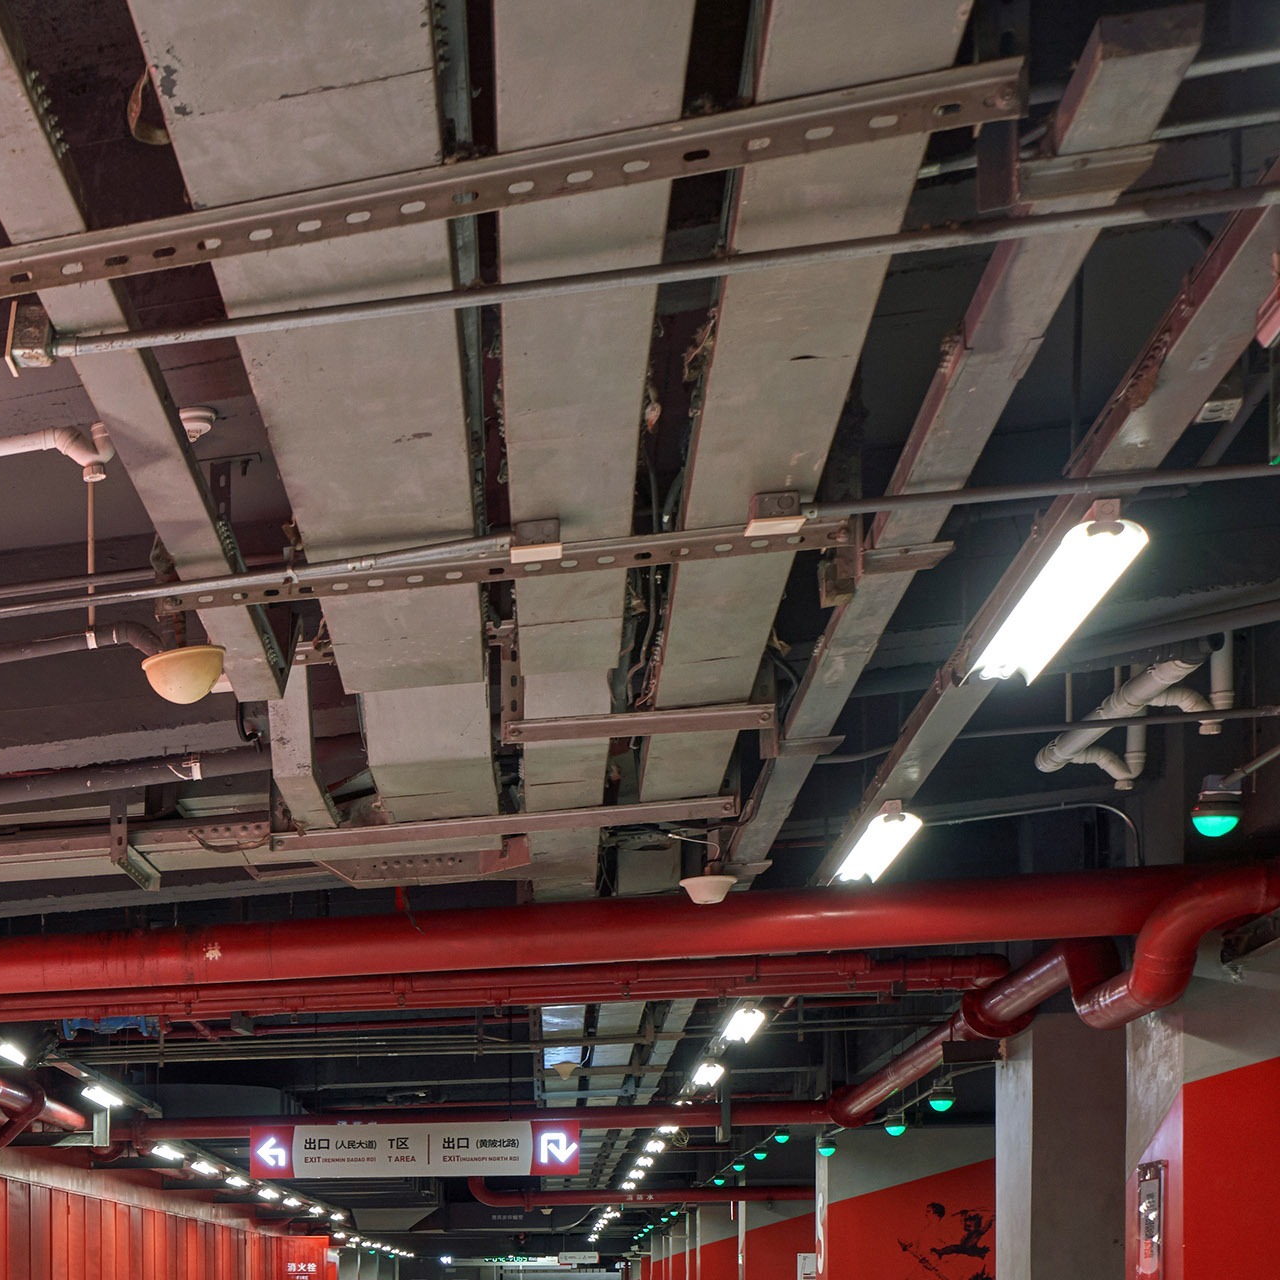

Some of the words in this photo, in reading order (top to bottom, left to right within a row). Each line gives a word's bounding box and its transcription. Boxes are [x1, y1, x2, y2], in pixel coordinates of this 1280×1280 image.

[304, 1138, 330, 1150] 出口
[335, 1140, 377, 1150] (人民大道)
[442, 1137, 470, 1149] 出口
[287, 1262, 317, 1272] 消火栓
